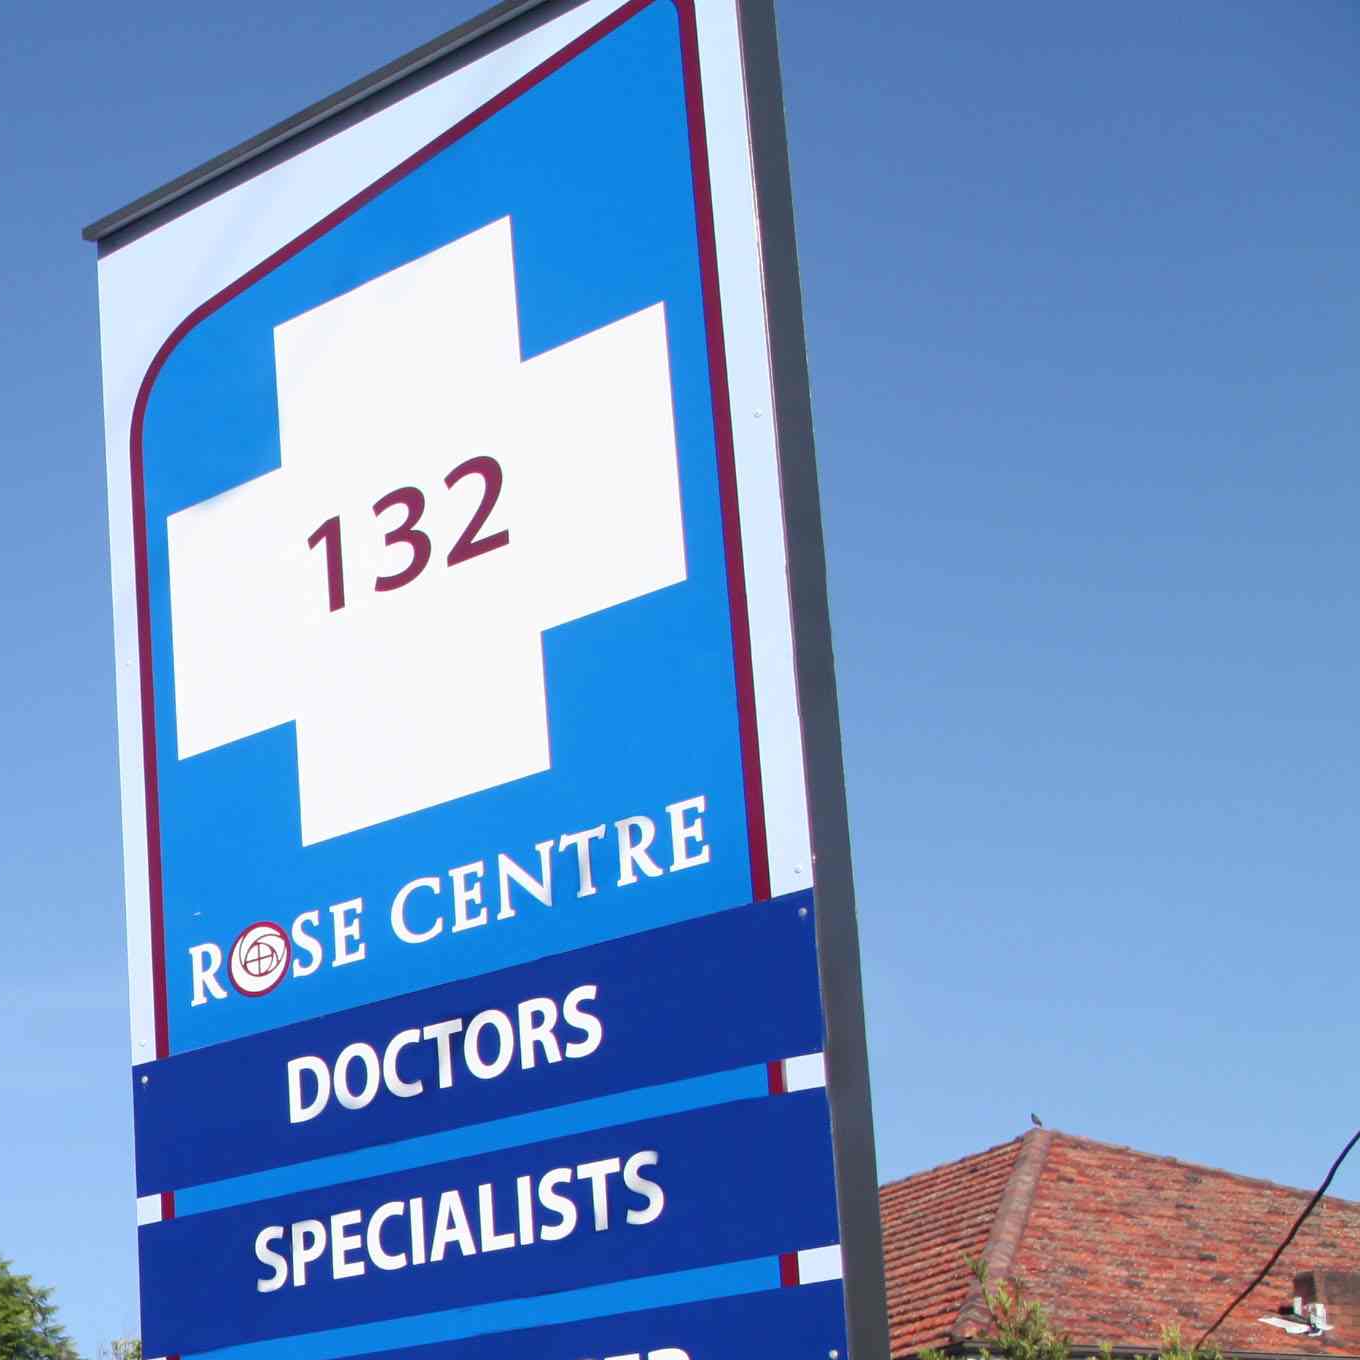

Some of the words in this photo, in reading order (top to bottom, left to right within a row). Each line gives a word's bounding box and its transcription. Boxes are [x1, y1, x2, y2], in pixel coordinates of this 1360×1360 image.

[306, 454, 511, 613] 132
[187, 895, 368, 1008] ROSE
[389, 794, 712, 945] CENTRE
[286, 983, 604, 1125] DOCTORS
[253, 1149, 666, 1294] SPECIALISTS
